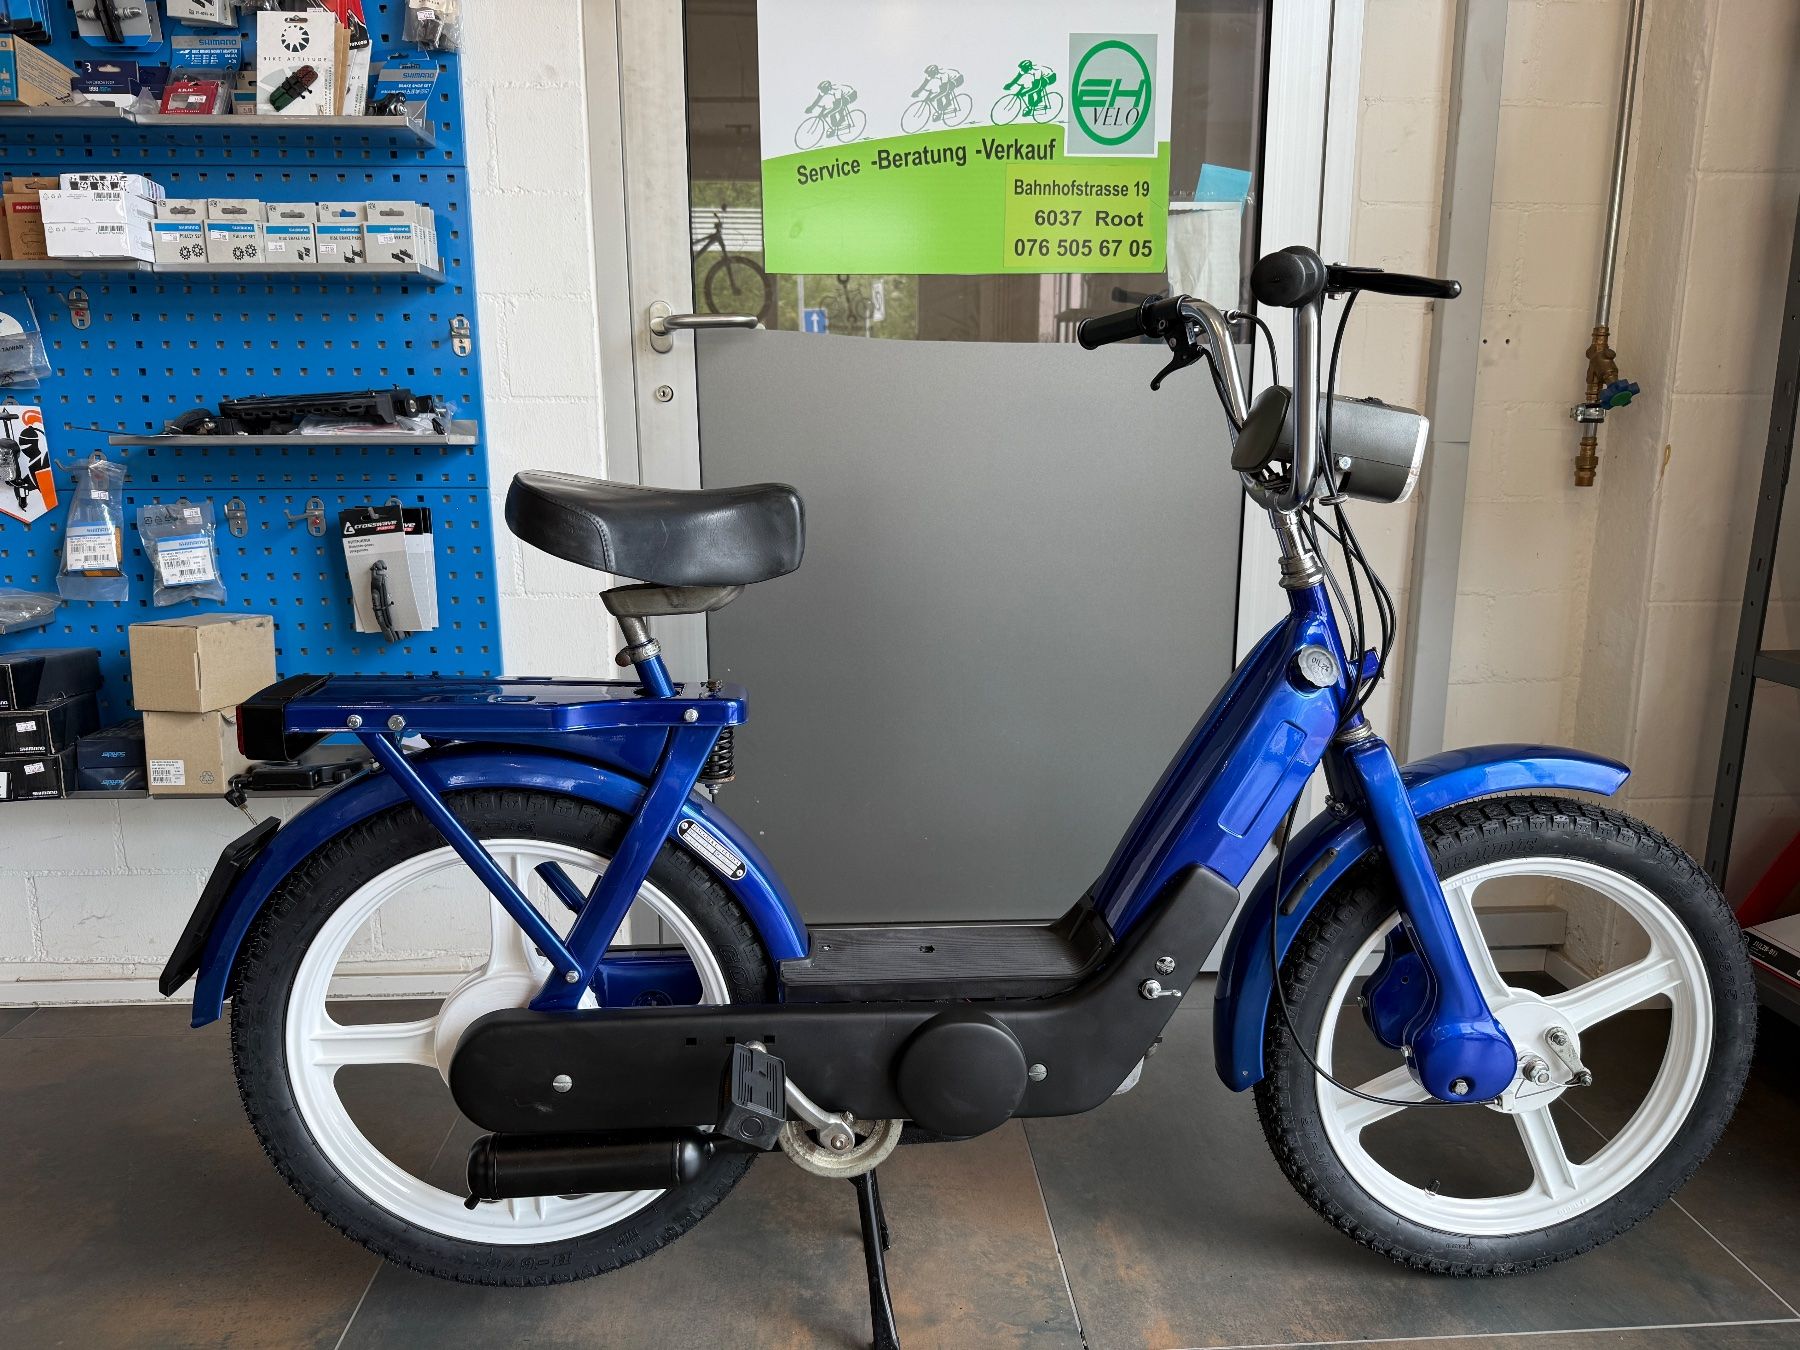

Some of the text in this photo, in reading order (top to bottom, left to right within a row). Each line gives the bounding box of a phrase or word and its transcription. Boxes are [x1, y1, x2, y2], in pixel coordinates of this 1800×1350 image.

[198, 38, 237, 46] SHIMANO
[402, 71, 435, 79] SHIMANO
[1091, 106, 1140, 127] VELO
[796, 138, 1057, 186] Service -Beratung -Verkauf
[1013, 178, 1151, 198] Bahnhofstrasse 19
[1034, 209, 1144, 228] 6037 Root
[1013, 238, 1153, 258] 076 505 67 05
[86, 526, 112, 534] SHIMAN
